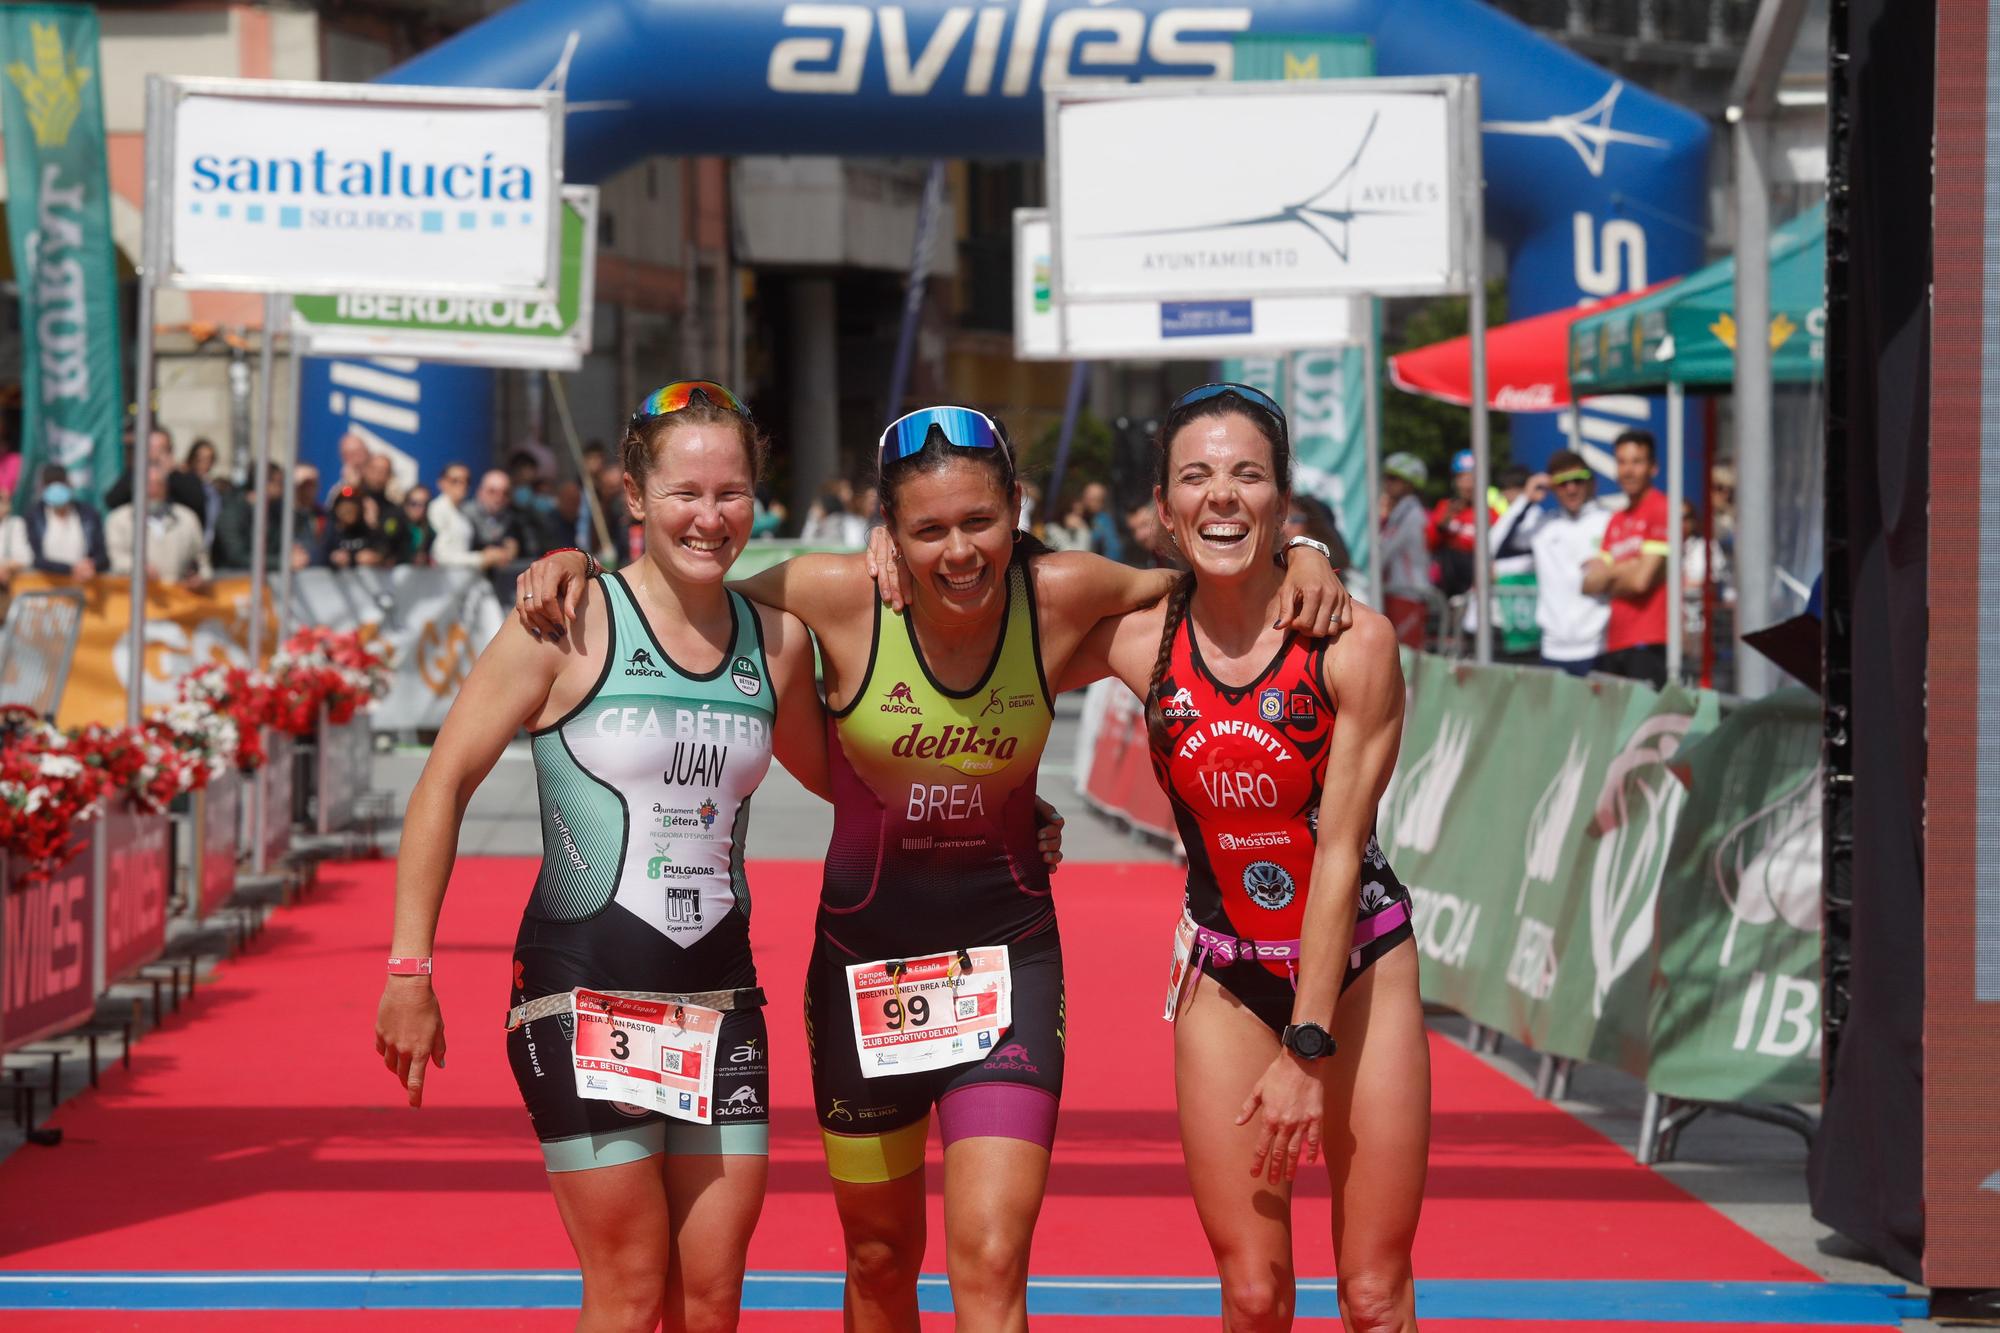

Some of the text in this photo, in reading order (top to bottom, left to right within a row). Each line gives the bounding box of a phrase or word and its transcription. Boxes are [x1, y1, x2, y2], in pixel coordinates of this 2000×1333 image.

[192, 148, 533, 201] santalucía
[1362, 180, 1440, 204] AVILÉS
[309, 209, 414, 230] SEGUROS
[1142, 248, 1299, 270] AYUNTAMIENTO
[625, 668, 667, 679] austral
[738, 660, 753, 673] CEA
[881, 703, 923, 715] austral
[1008, 698, 1035, 708] DELIKIA
[1165, 707, 1202, 717] austral
[595, 704, 772, 748] CEA BÉTERA
[891, 722, 1018, 760] delikia
[1179, 719, 1292, 763] TRI INFINITY
[663, 741, 727, 788] JUAN
[962, 759, 993, 770] fresh
[1199, 770, 1278, 808] VARO
[653, 802, 694, 815] ajuntament
[906, 782, 985, 822] BREA
[662, 815, 699, 828] Bétera
[934, 839, 987, 848] PONTEVEDRA
[1234, 835, 1291, 847] Móstoles
[664, 865, 715, 876] PULGADAS
[914, 963, 941, 972] España
[857, 989, 888, 1000] JOSELYN
[920, 981, 940, 991] BREA
[882, 996, 930, 1030] 99
[626, 1021, 656, 1033] PASTOR
[610, 1030, 630, 1060] 3
[863, 1027, 958, 1048] CLUB DEPORTIVO DELIKIA
[528, 1043, 545, 1077] Duval
[576, 1058, 629, 1075] C.E.A. BETERA
[984, 1060, 1039, 1073] austral
[715, 1105, 765, 1116] austral
